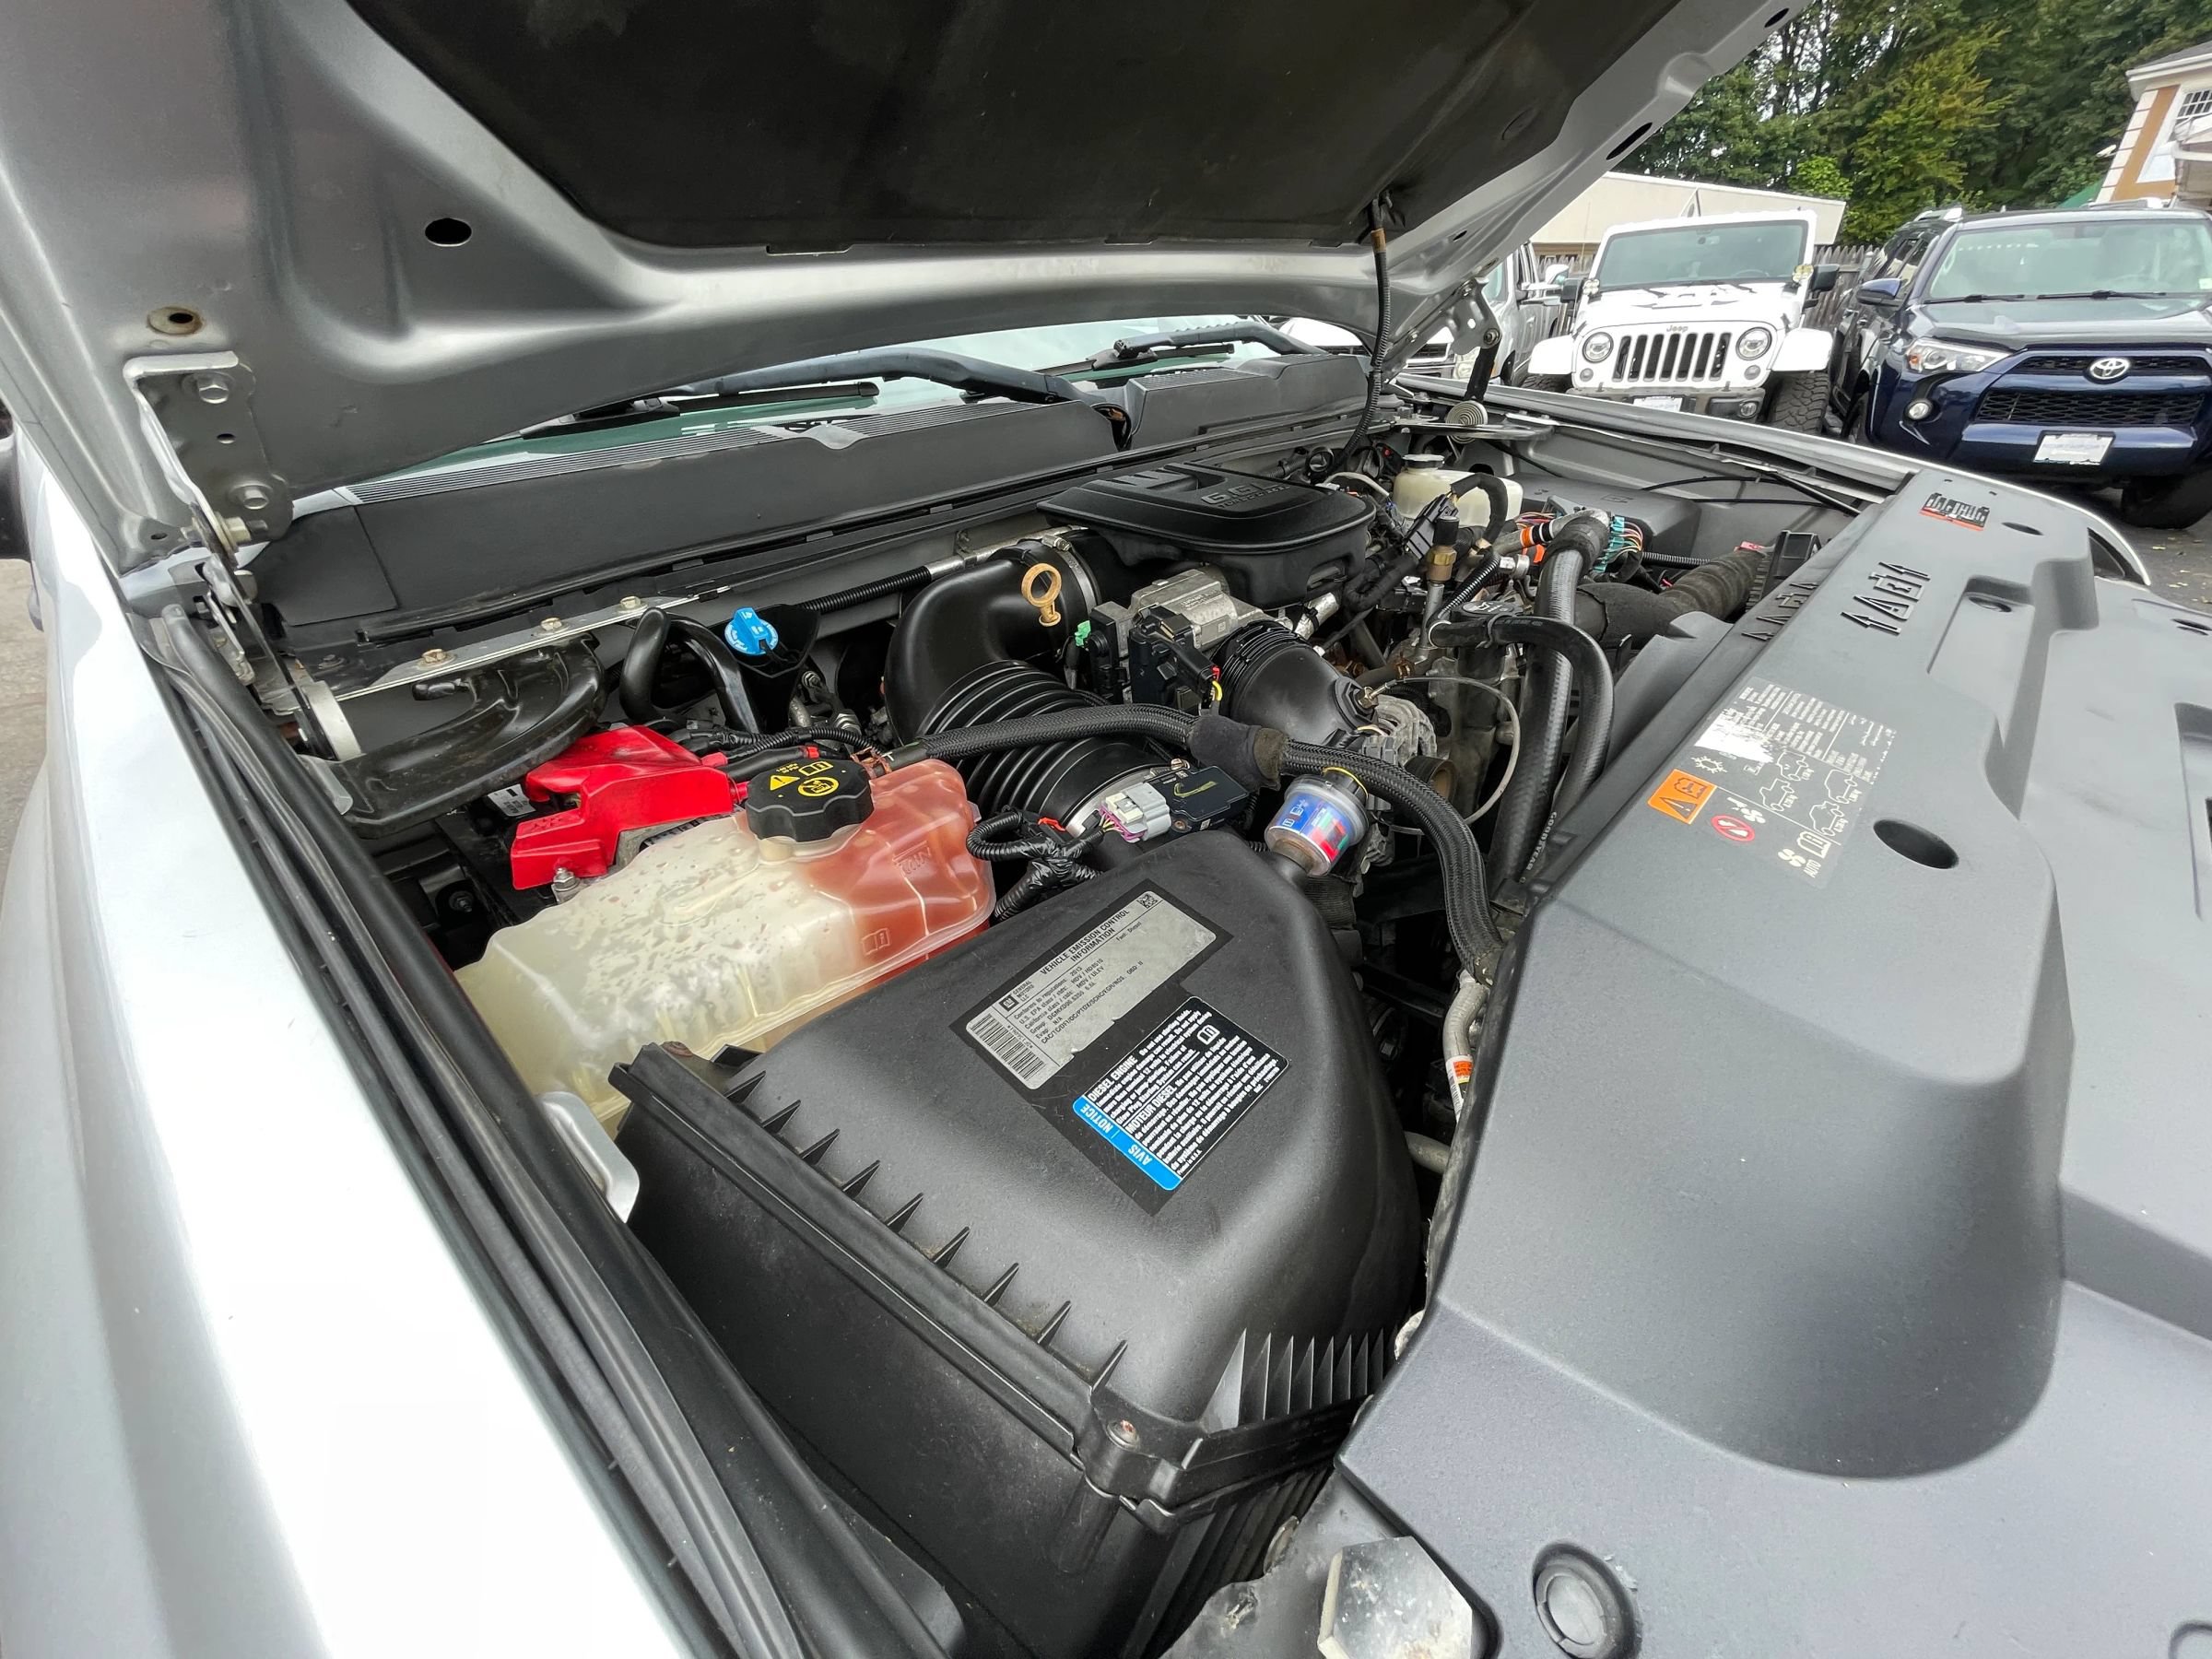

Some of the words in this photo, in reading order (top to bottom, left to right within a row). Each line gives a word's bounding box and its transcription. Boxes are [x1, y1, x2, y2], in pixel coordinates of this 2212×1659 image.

[1666, 324, 1688, 334] Jeep
[1804, 859, 1822, 878] AUTO
[1039, 951, 1070, 975] VEHICLE
[1067, 928, 1102, 954] EMISSION
[1098, 907, 1131, 932] CONTROL
[1068, 926, 1116, 962] INFORMATION
[1011, 979, 1032, 995] GENERAL
[1015, 983, 1035, 998] MOTORS
[1019, 994, 1030, 1002] LLC
[1029, 1005, 1042, 1016] EPA
[1051, 1015, 1064, 1026] N/A
[1086, 1076, 1115, 1102] DIESEL
[1109, 1053, 1139, 1081] ENGINE
[1078, 1101, 1114, 1134] NOTICE
[1124, 1102, 1157, 1134] MOTEUR
[1149, 1082, 1178, 1108] DIESEL
[1125, 1142, 1154, 1168] AVIS
